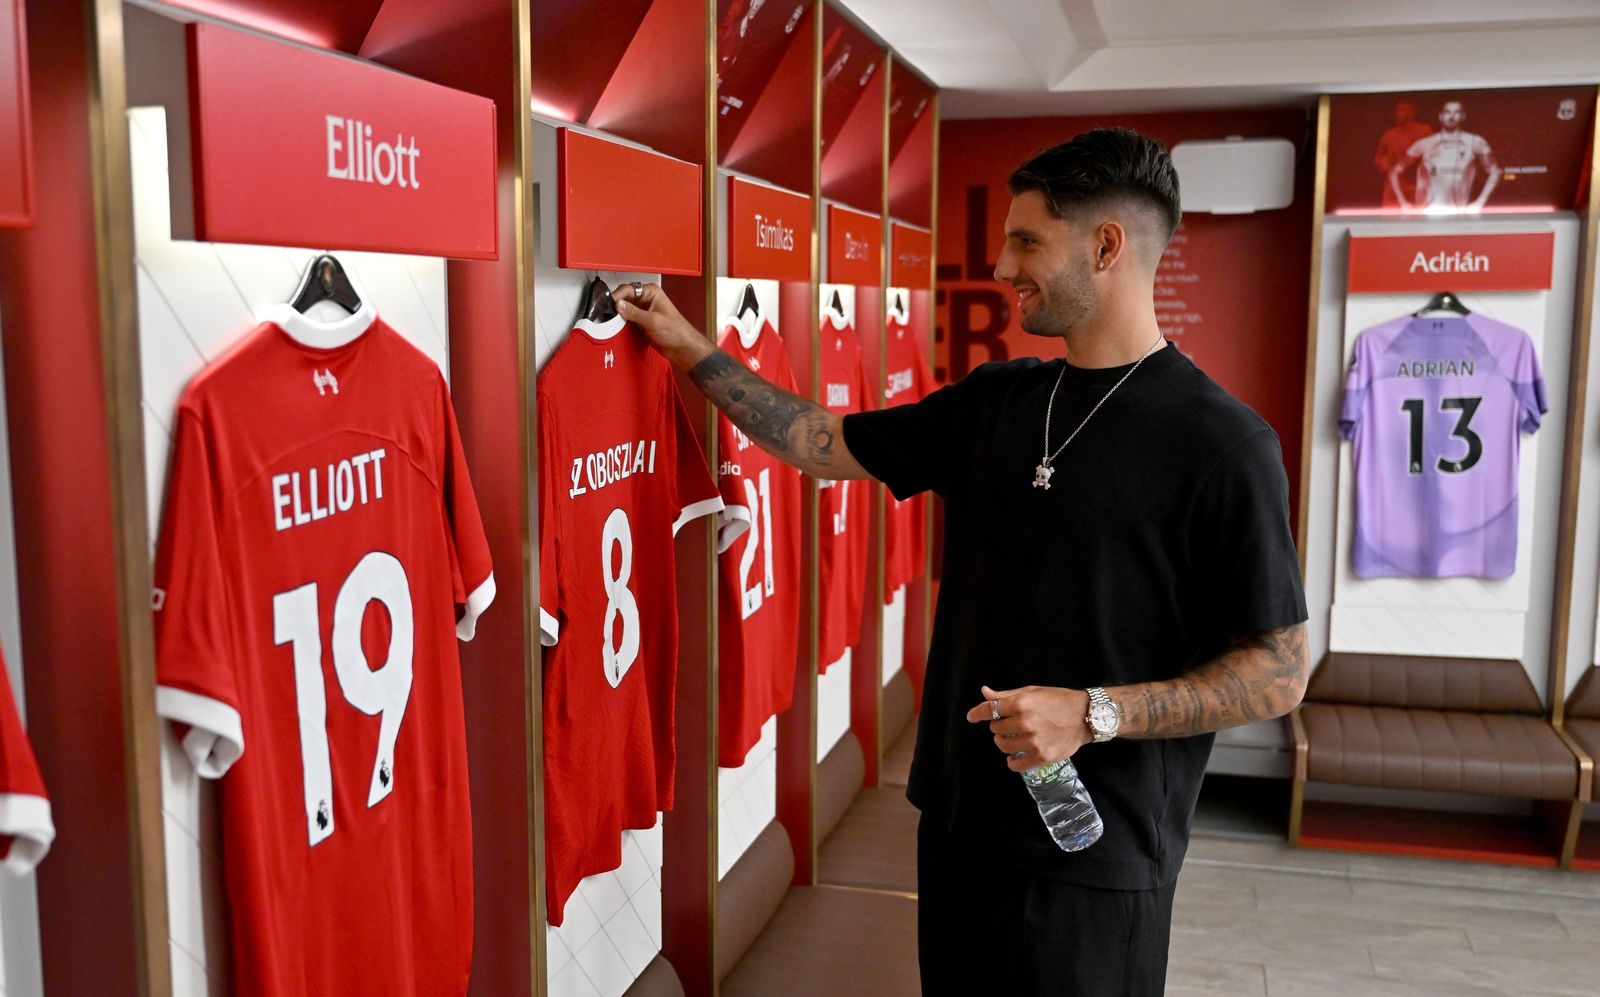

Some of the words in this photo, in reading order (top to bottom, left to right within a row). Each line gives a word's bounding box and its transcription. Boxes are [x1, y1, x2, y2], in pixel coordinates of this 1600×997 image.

[325, 115, 420, 190] Elliott
[755, 214, 794, 252] Tsimikas
[1409, 251, 1490, 273] Adrián
[1396, 360, 1475, 378] ADRIAN
[1401, 397, 1484, 475] 13
[272, 448, 386, 532] ELLIOTT
[739, 467, 775, 621] 21
[601, 508, 641, 689] 8
[272, 550, 415, 848] 19
